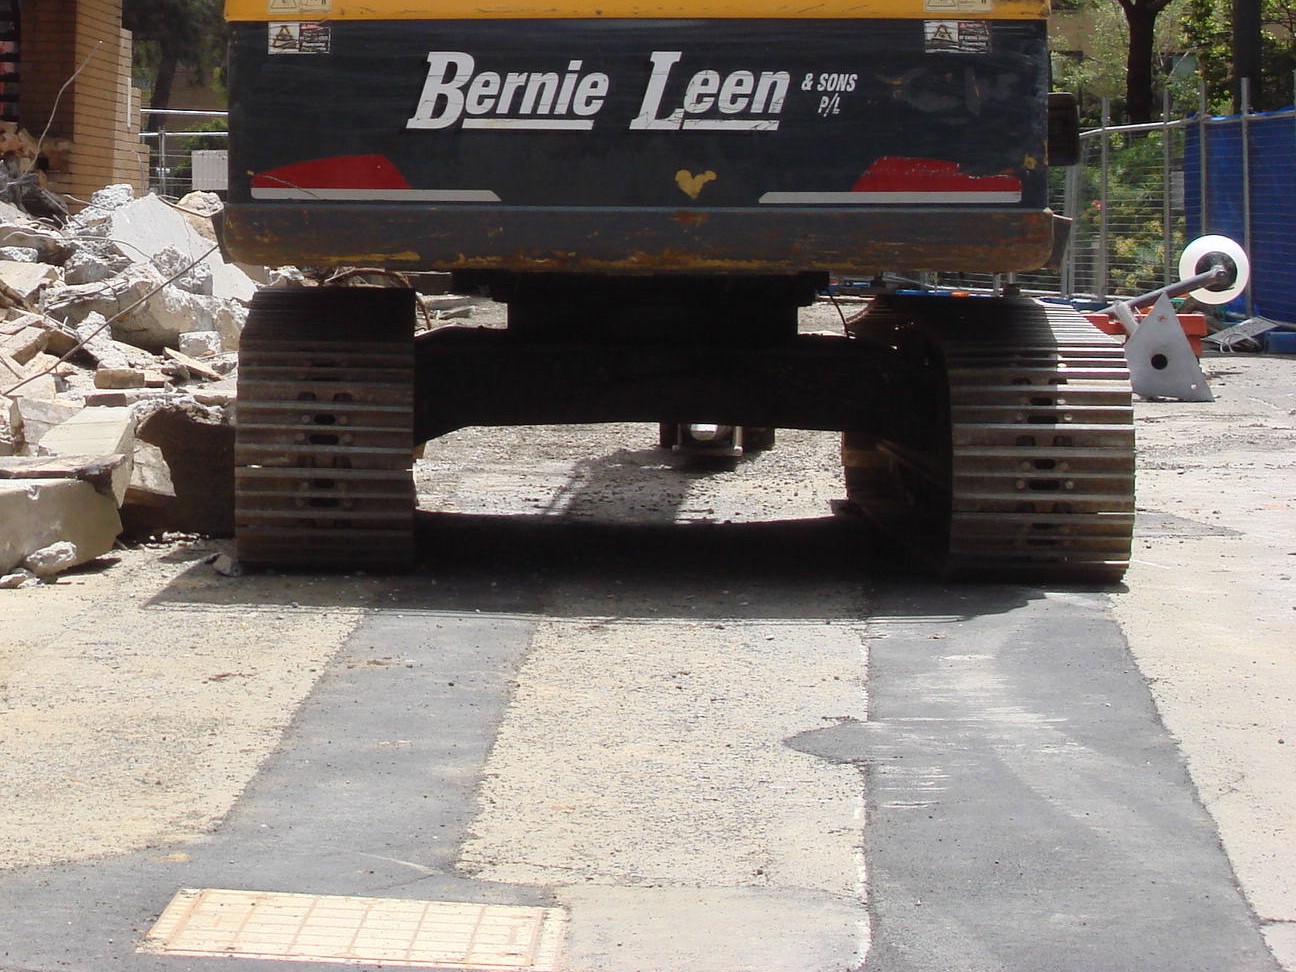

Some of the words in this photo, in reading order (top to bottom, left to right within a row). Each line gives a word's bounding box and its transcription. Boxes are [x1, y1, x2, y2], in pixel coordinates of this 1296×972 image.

[406, 51, 610, 130] Bernie
[629, 51, 791, 131] Leen
[801, 73, 814, 91] &
[817, 73, 858, 92] SONS
[817, 92, 841, 118] P/L
